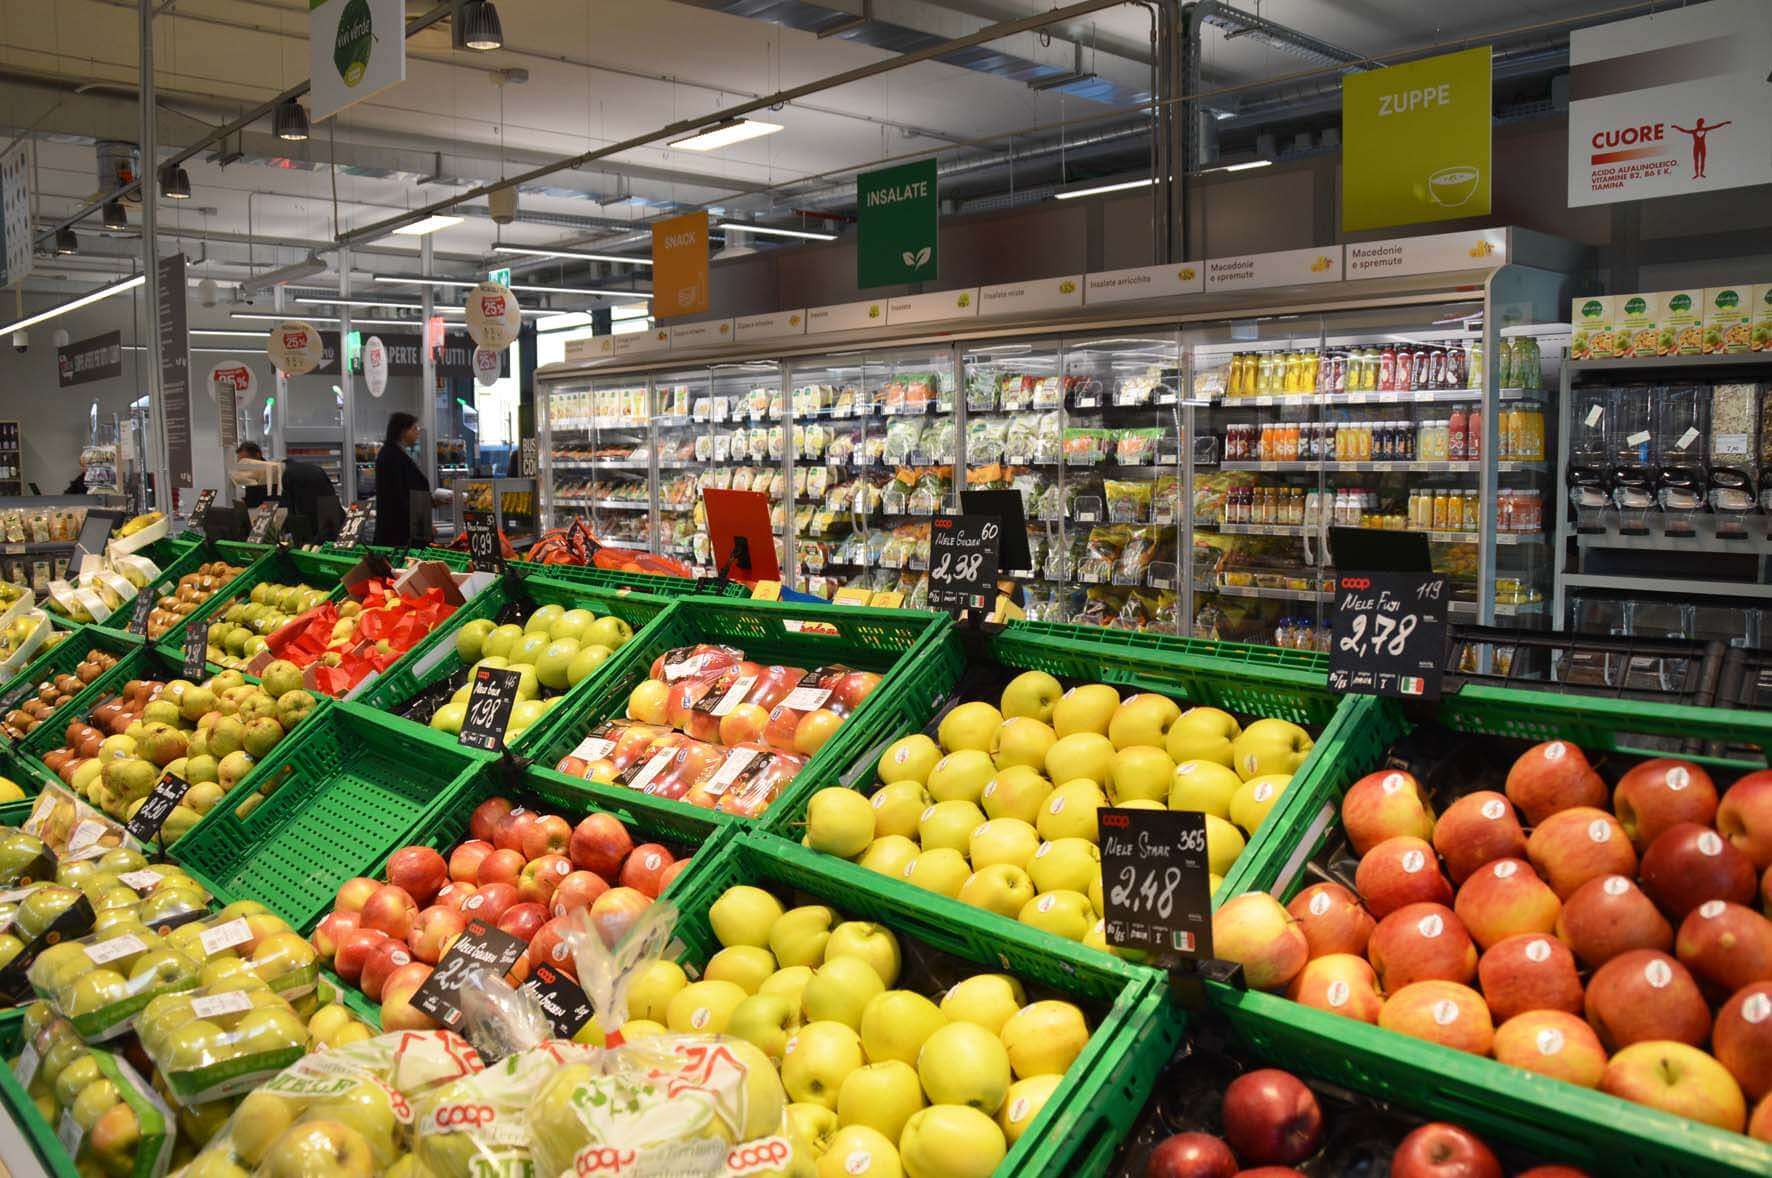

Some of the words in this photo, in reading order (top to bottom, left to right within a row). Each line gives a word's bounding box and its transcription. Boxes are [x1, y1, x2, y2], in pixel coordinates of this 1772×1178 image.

[1378, 83, 1450, 116] ZUPPE
[1592, 123, 1665, 149] CUORE
[1592, 168, 1616, 177] ACIDO
[1592, 173, 1627, 184] VITAMINE
[866, 179, 928, 208] INSALATE
[1592, 182, 1624, 191] TIAMINA
[664, 231, 696, 249] SNACK
[1352, 244, 1402, 258] Macedonie
[1211, 260, 1254, 272] Macedonie
[1359, 257, 1402, 269] spremute
[1217, 270, 1254, 283] spremute
[981, 522, 999, 541] 60
[1340, 577, 1371, 591] coop
[1416, 580, 1443, 600] 119
[1339, 613, 1418, 658] 2,78
[1177, 829, 1205, 852] 365
[1110, 866, 1181, 919] 2,48
[435, 1104, 495, 1130] coop
[726, 1140, 788, 1167] coop
